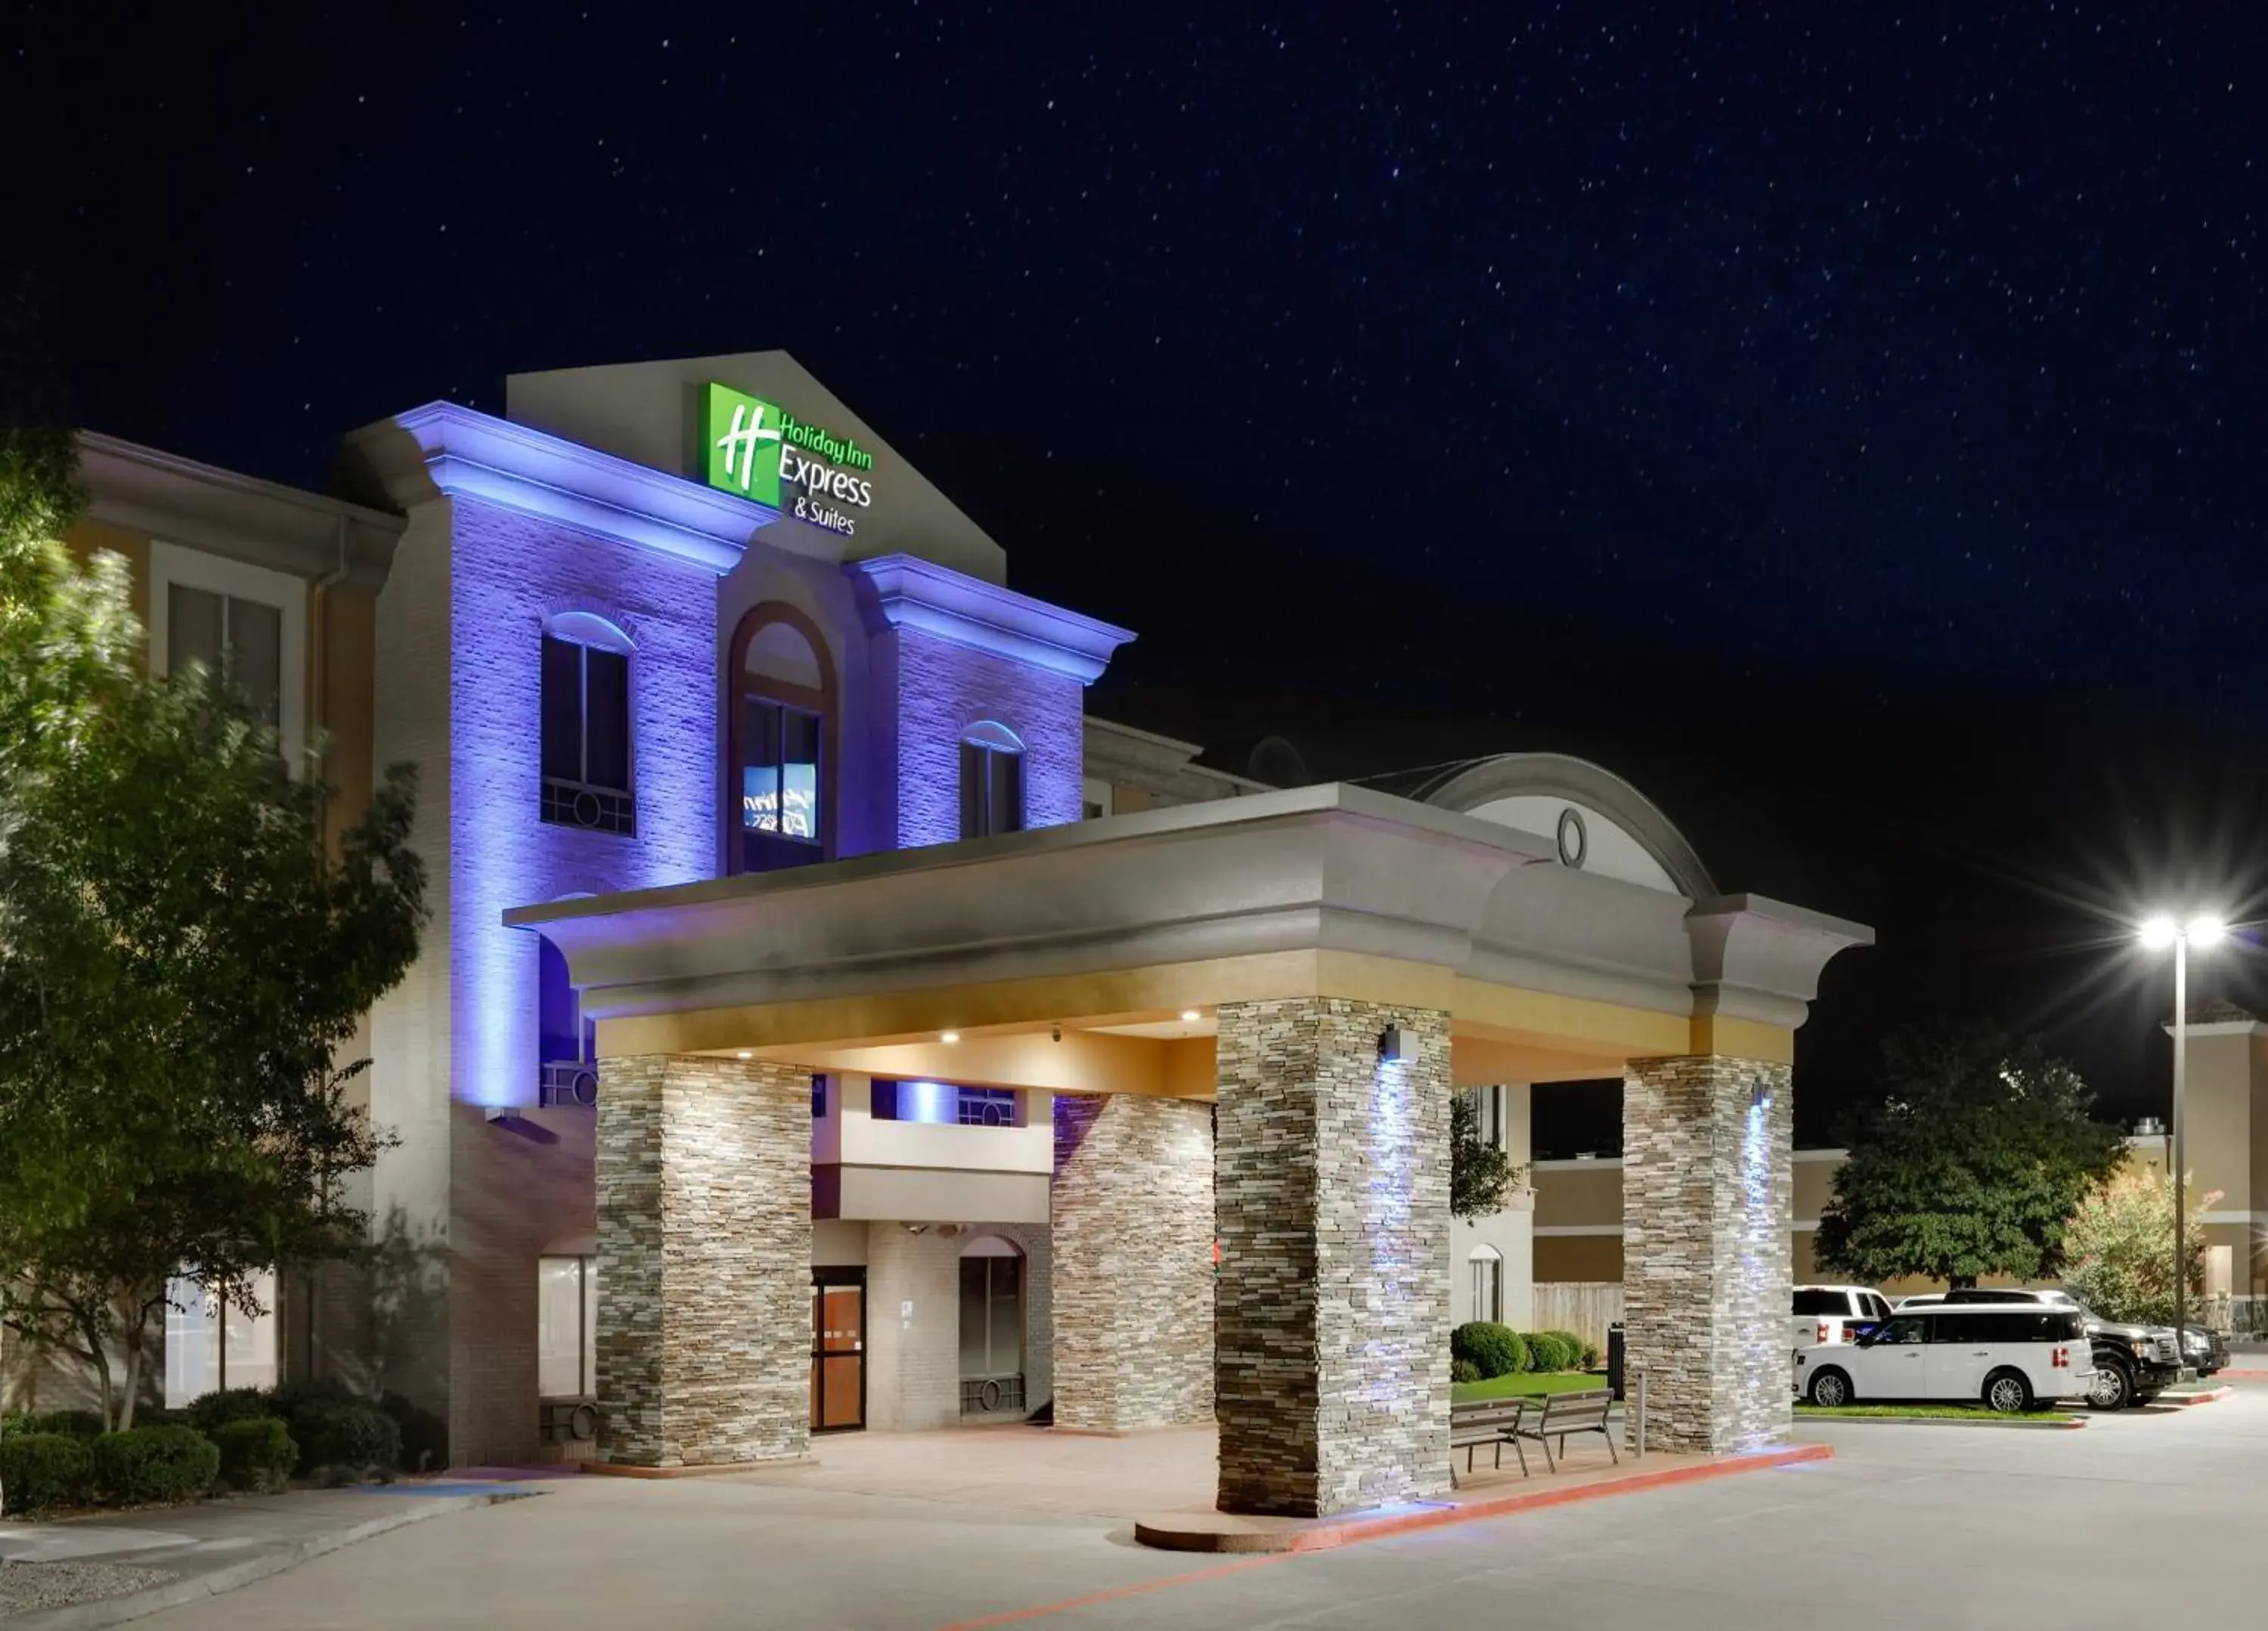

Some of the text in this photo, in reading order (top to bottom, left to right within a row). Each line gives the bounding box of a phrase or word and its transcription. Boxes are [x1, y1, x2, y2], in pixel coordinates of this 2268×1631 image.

[780, 413, 872, 470] Holiday Inn
[779, 444, 872, 507] Express
[795, 497, 856, 535] & Suites
